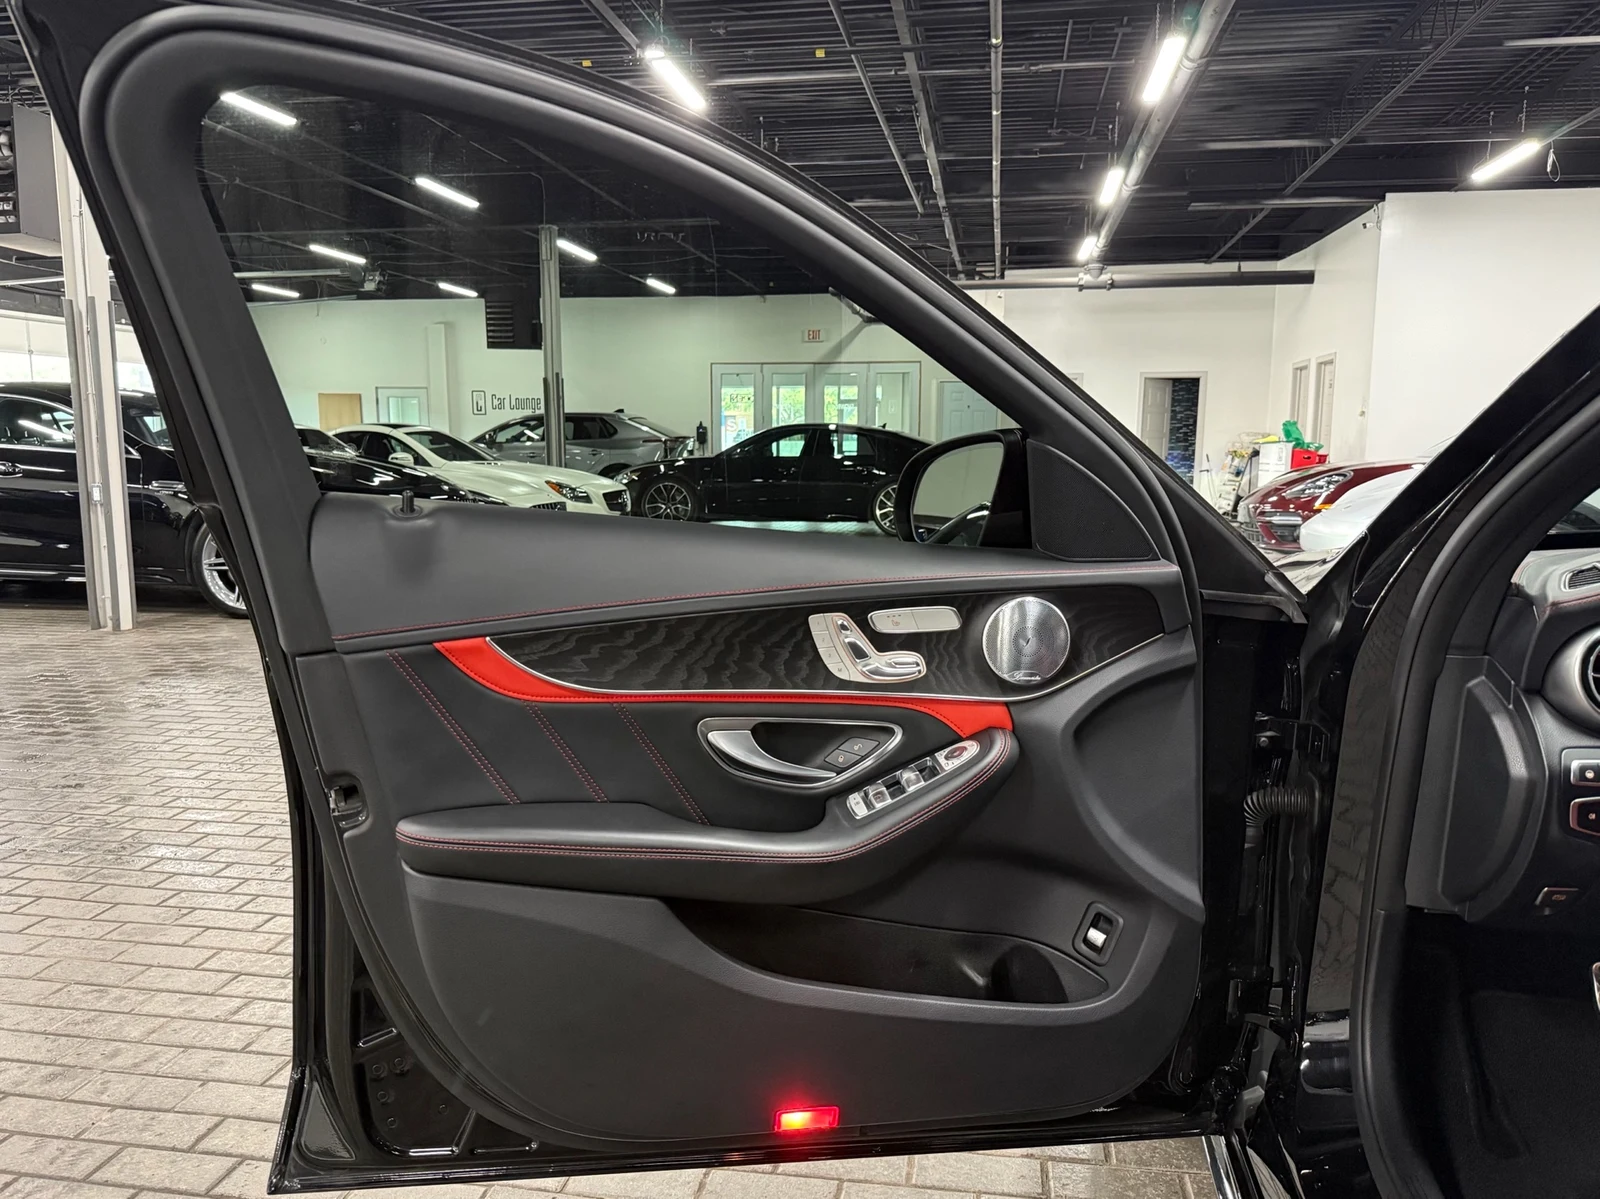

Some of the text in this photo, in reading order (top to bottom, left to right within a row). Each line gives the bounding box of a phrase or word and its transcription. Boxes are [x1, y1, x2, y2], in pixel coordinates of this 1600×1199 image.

[807, 329, 821, 341] EXIT
[491, 394, 541, 413] Car Lounge
